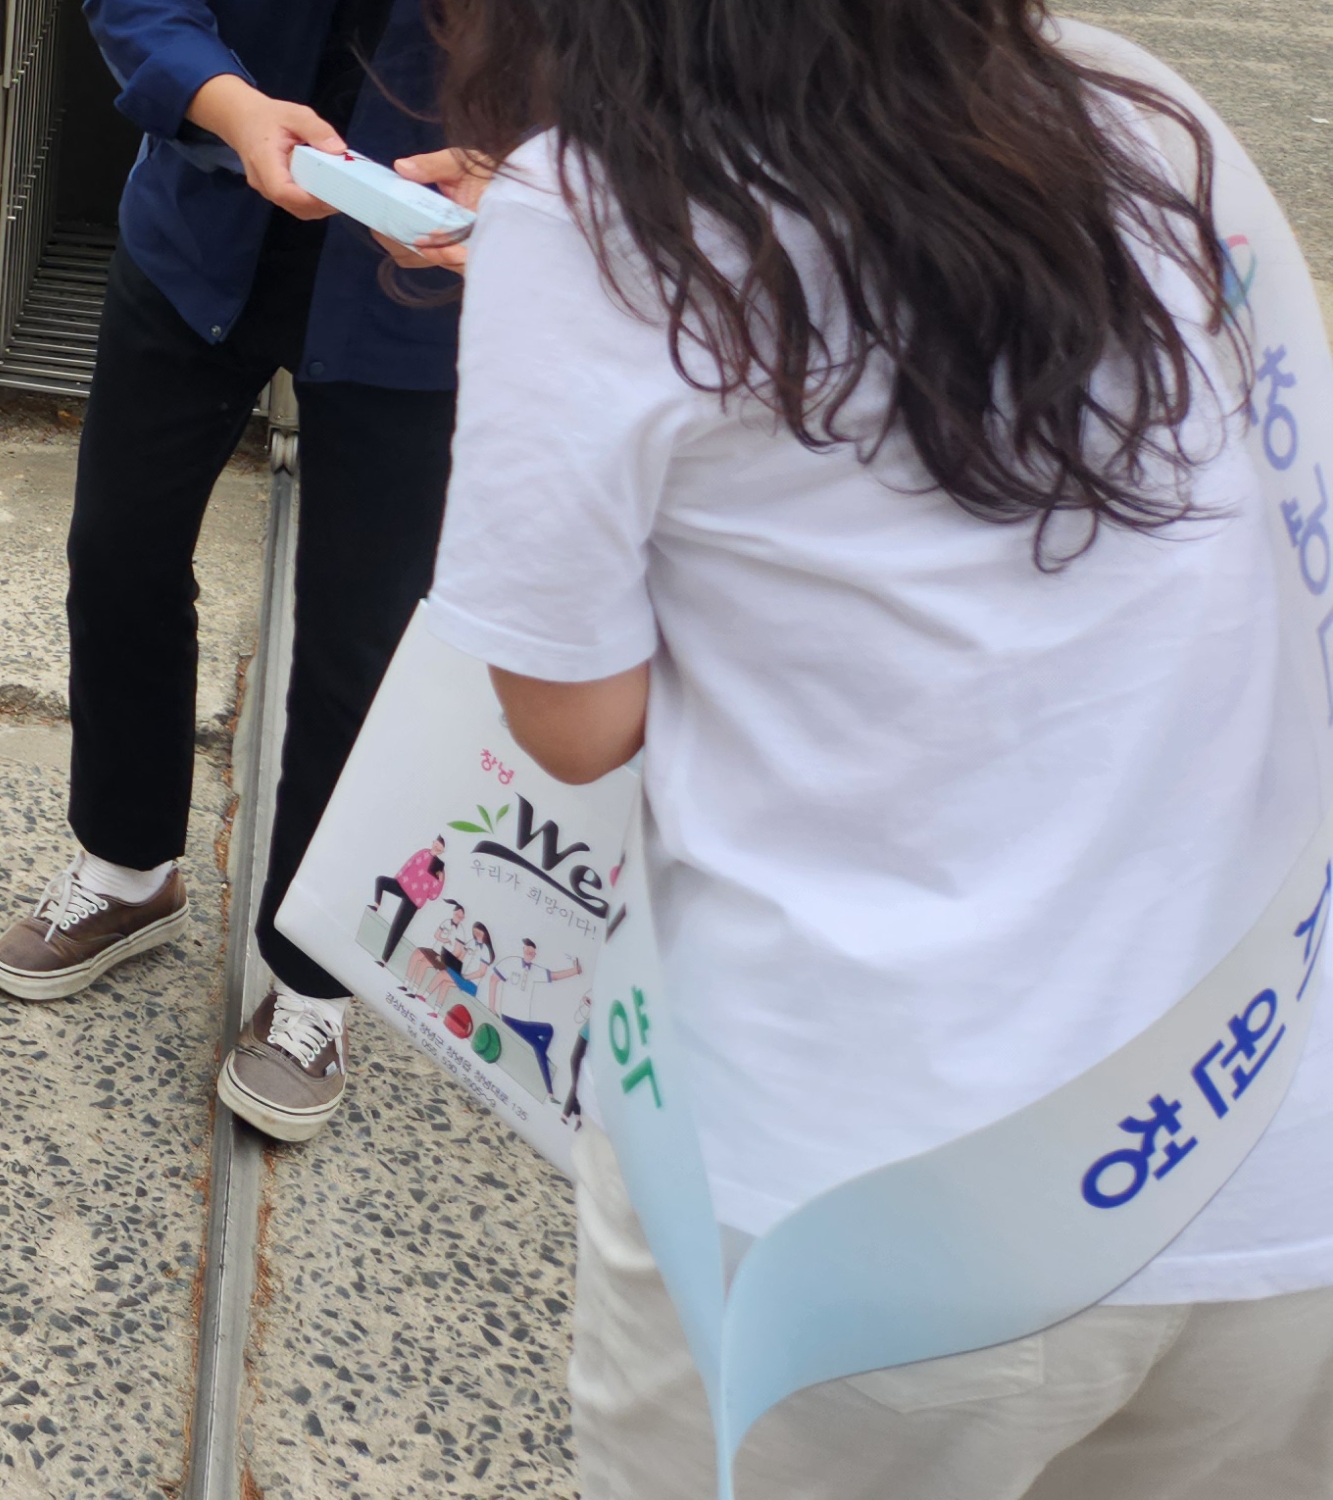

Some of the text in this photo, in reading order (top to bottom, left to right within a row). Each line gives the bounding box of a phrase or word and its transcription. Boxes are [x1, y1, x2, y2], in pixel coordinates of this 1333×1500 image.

[480, 748, 514, 785] 창녕
[470, 858, 598, 940] 우리가 희망이다!
[473, 792, 621, 918] We
[385, 992, 529, 1122] 경상남도 창녕군 창녕읍 창녕대로 135
